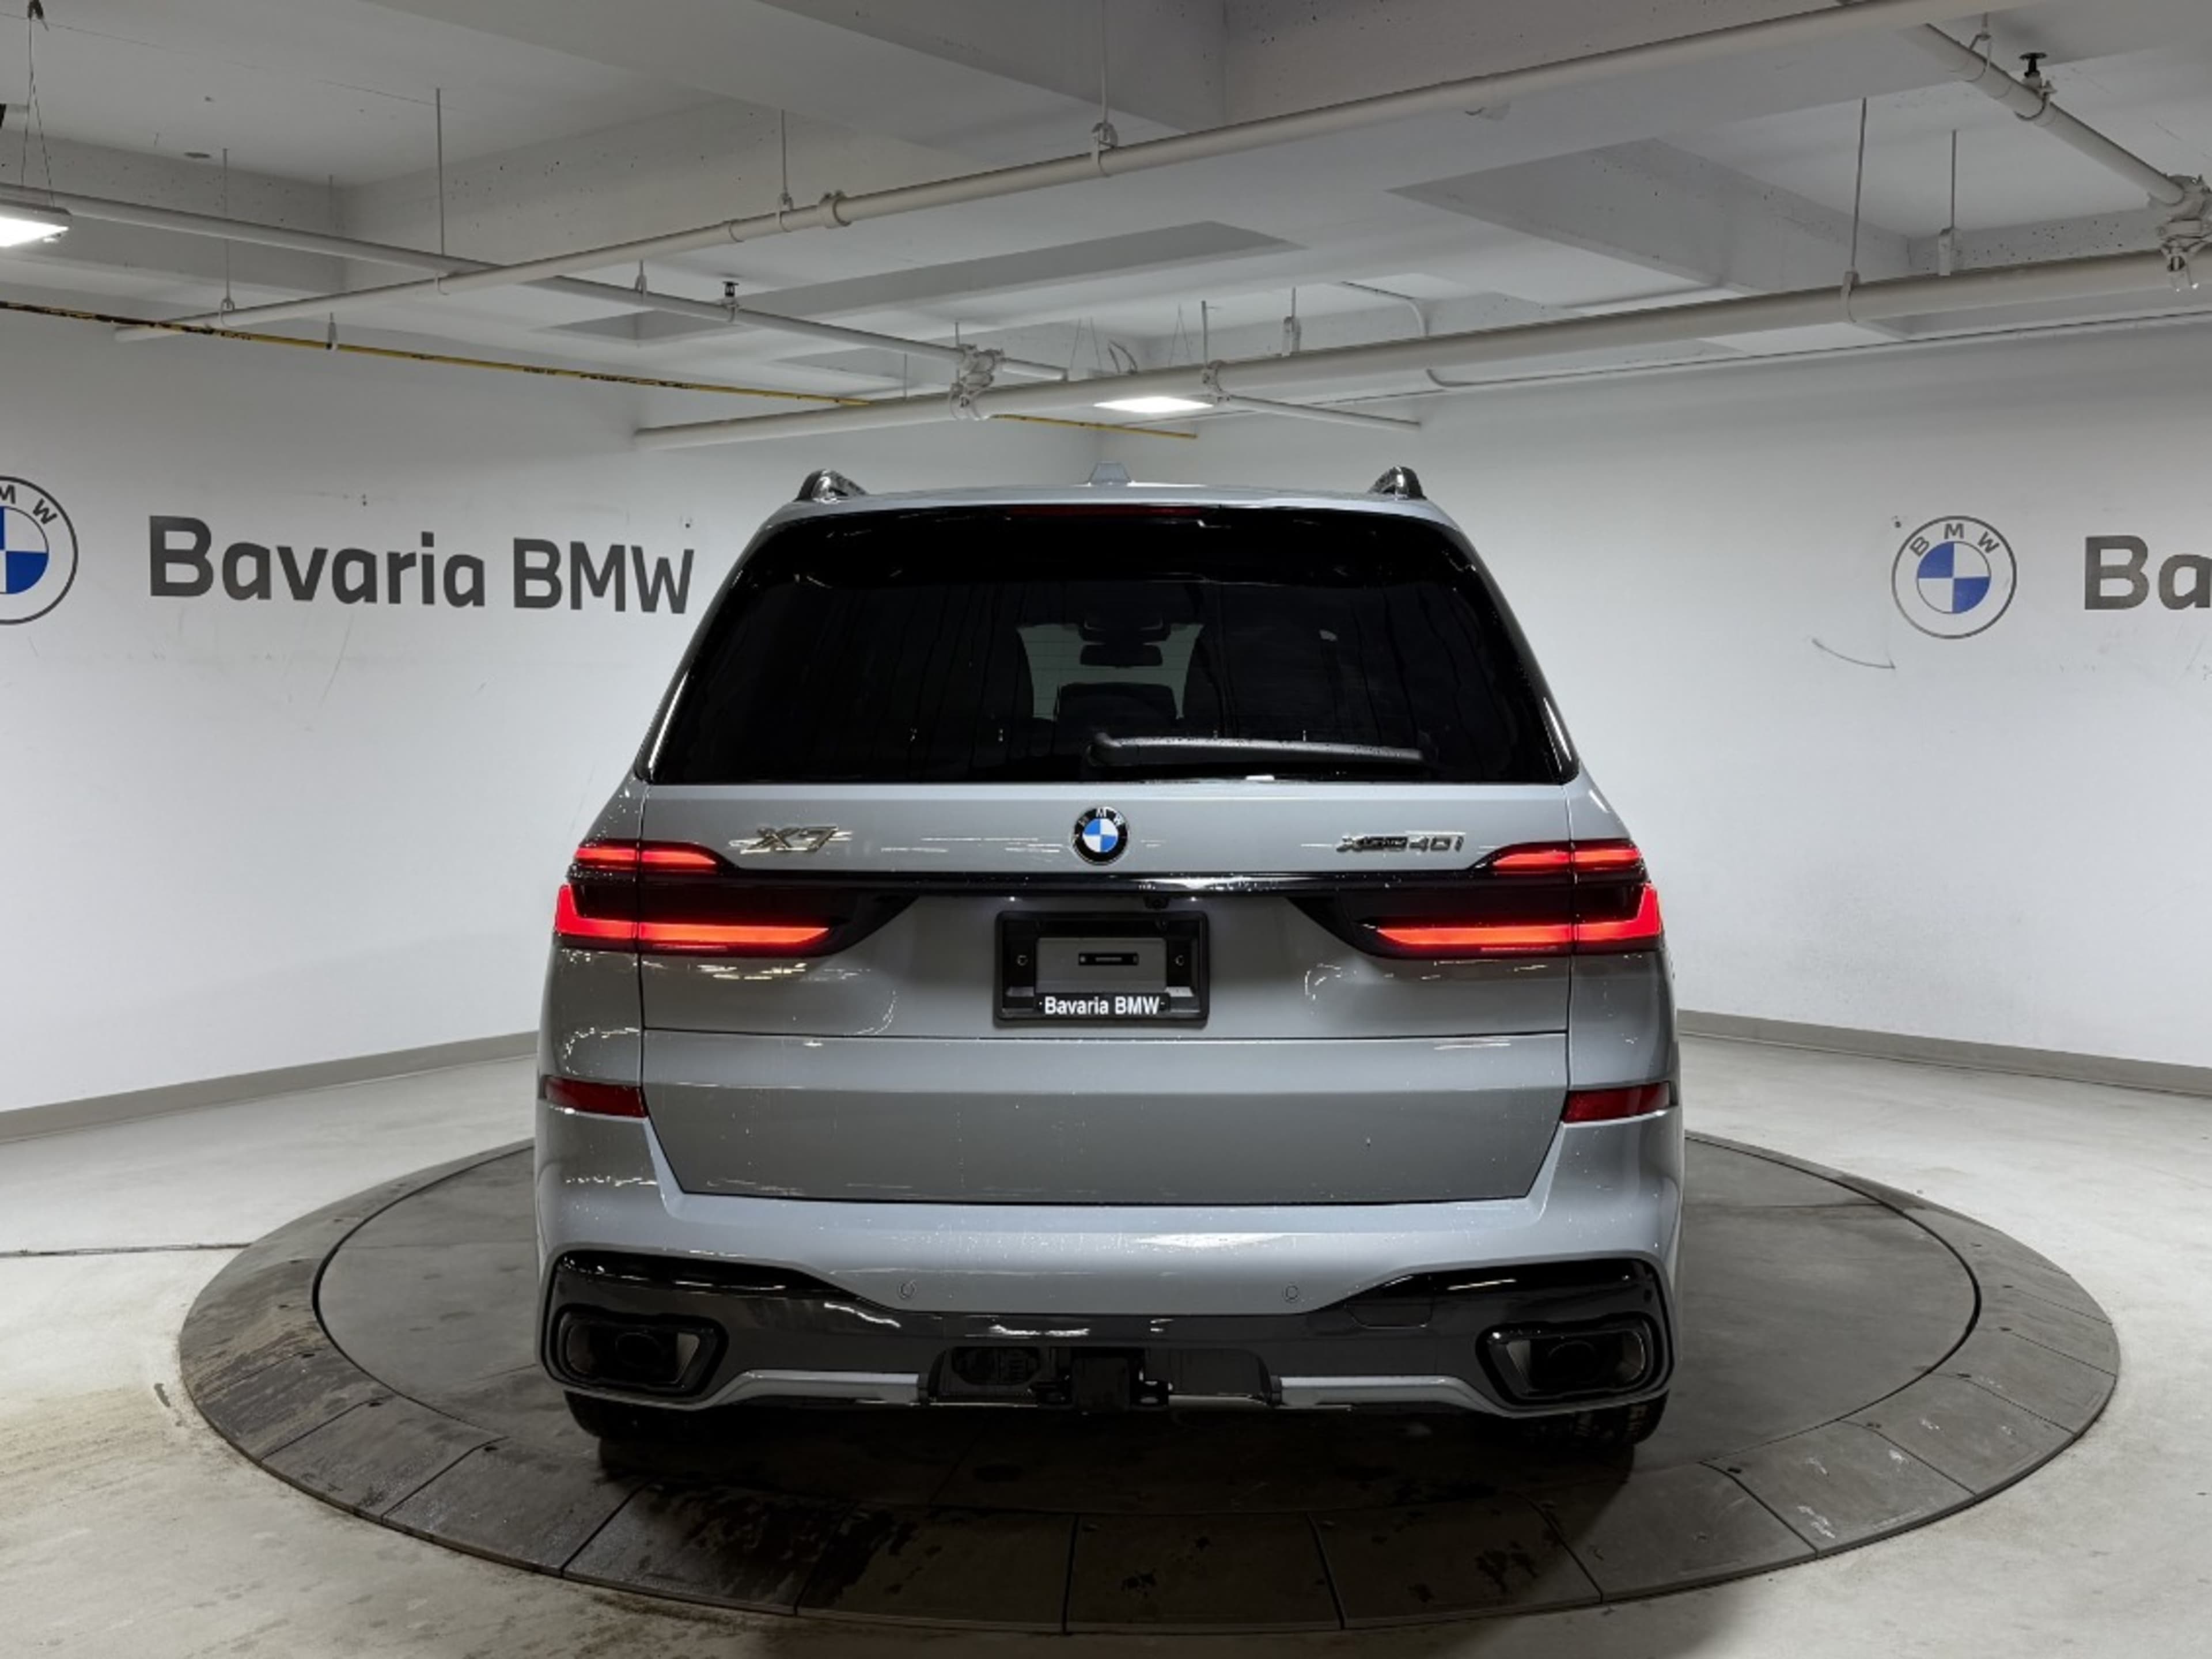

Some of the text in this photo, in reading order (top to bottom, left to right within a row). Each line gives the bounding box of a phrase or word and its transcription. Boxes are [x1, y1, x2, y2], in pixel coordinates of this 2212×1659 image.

[1910, 523, 2000, 556] BMW
[149, 515, 694, 614] Bavaria BMW
[748, 826, 839, 853] X7
[1044, 996, 1160, 1015] Bavaria BMW
